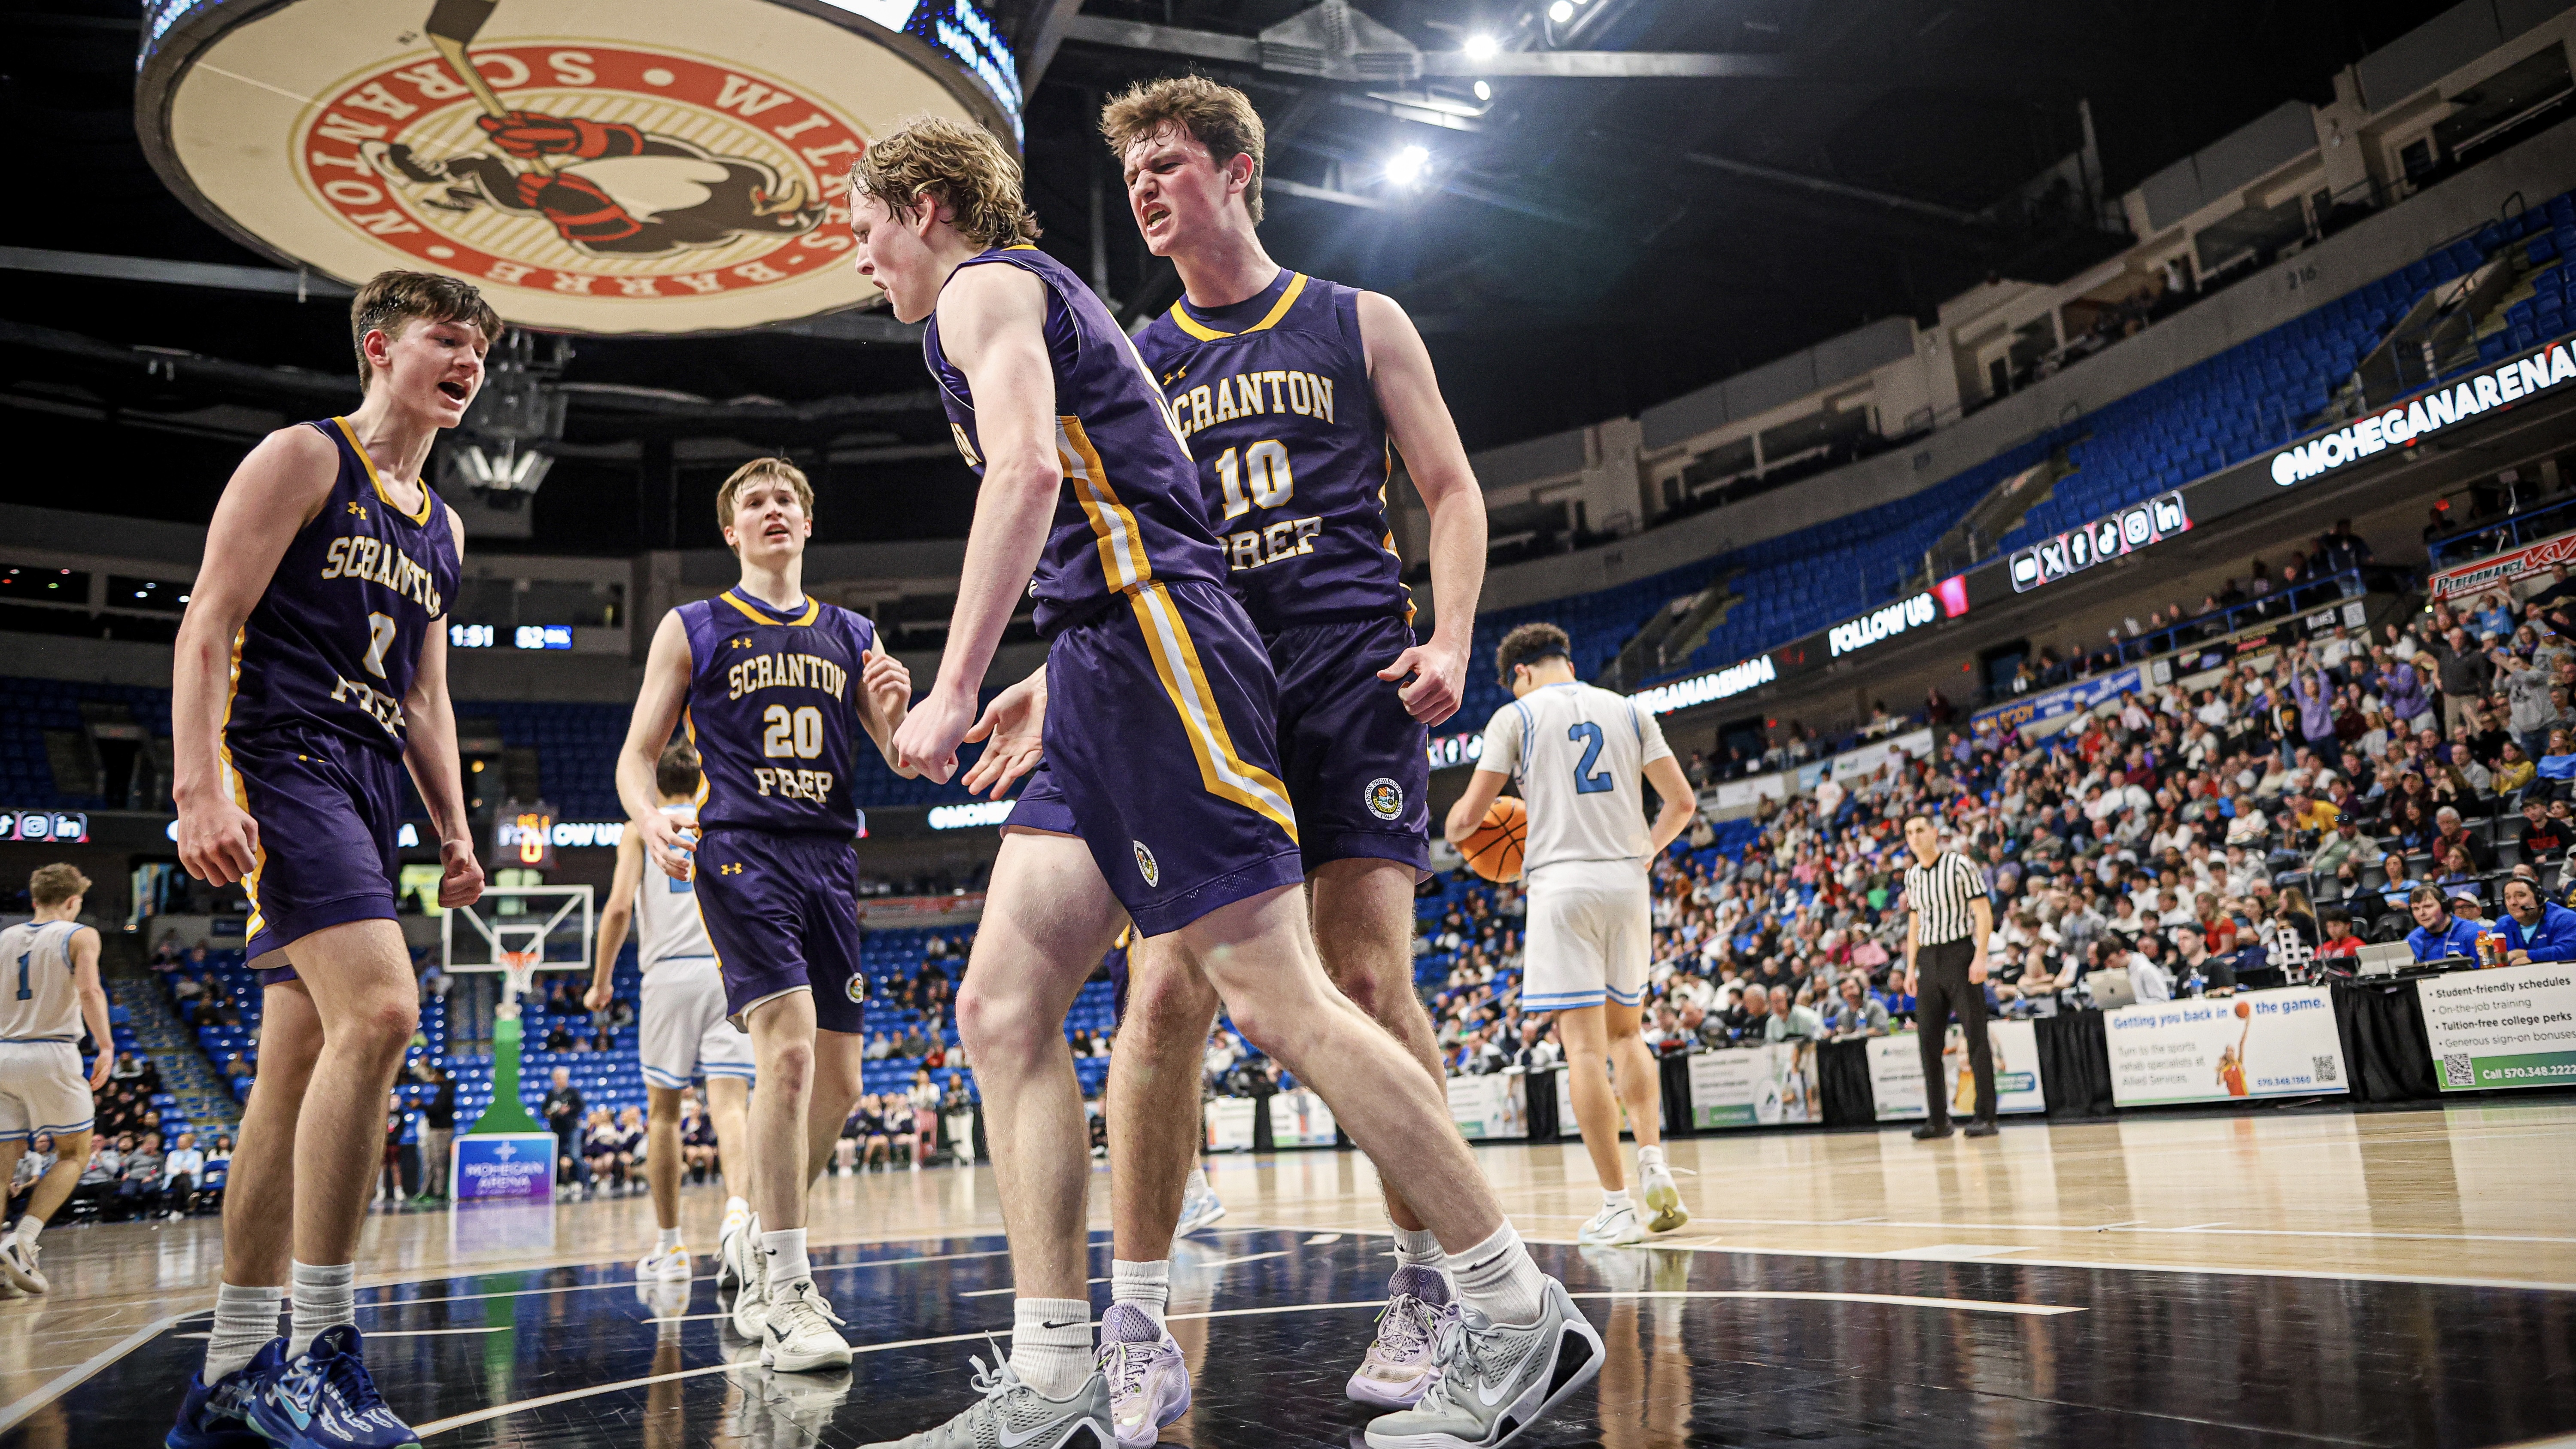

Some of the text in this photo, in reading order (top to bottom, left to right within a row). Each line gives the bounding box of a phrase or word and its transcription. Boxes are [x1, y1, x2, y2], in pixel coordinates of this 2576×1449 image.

[1172, 371, 1334, 439] CRANTON
[2271, 338, 2576, 486] @MOHEGANARENA
[1215, 439, 1294, 520] 10
[321, 535, 441, 618] SCRANTO
[1829, 591, 1935, 657] FOLLOW US
[729, 653, 847, 703] SCRANTON
[763, 704, 824, 759] 20
[1568, 721, 1614, 795] 2
[754, 768, 833, 804] PREP
[1371, 778, 1402, 795] PREPARATORY
[16, 951, 33, 1000] 1
[2437, 976, 2571, 998] Student-friendly schedules
[2114, 998, 2326, 1029] Getting you back in the game.
[2439, 998, 2532, 1015] On-the-job training
[2442, 1012, 2572, 1031] Tuition-free college perks
[2445, 1029, 2576, 1048] Generous sign-on bonuses
[2482, 1064, 2576, 1080] Call 570.348.2222
